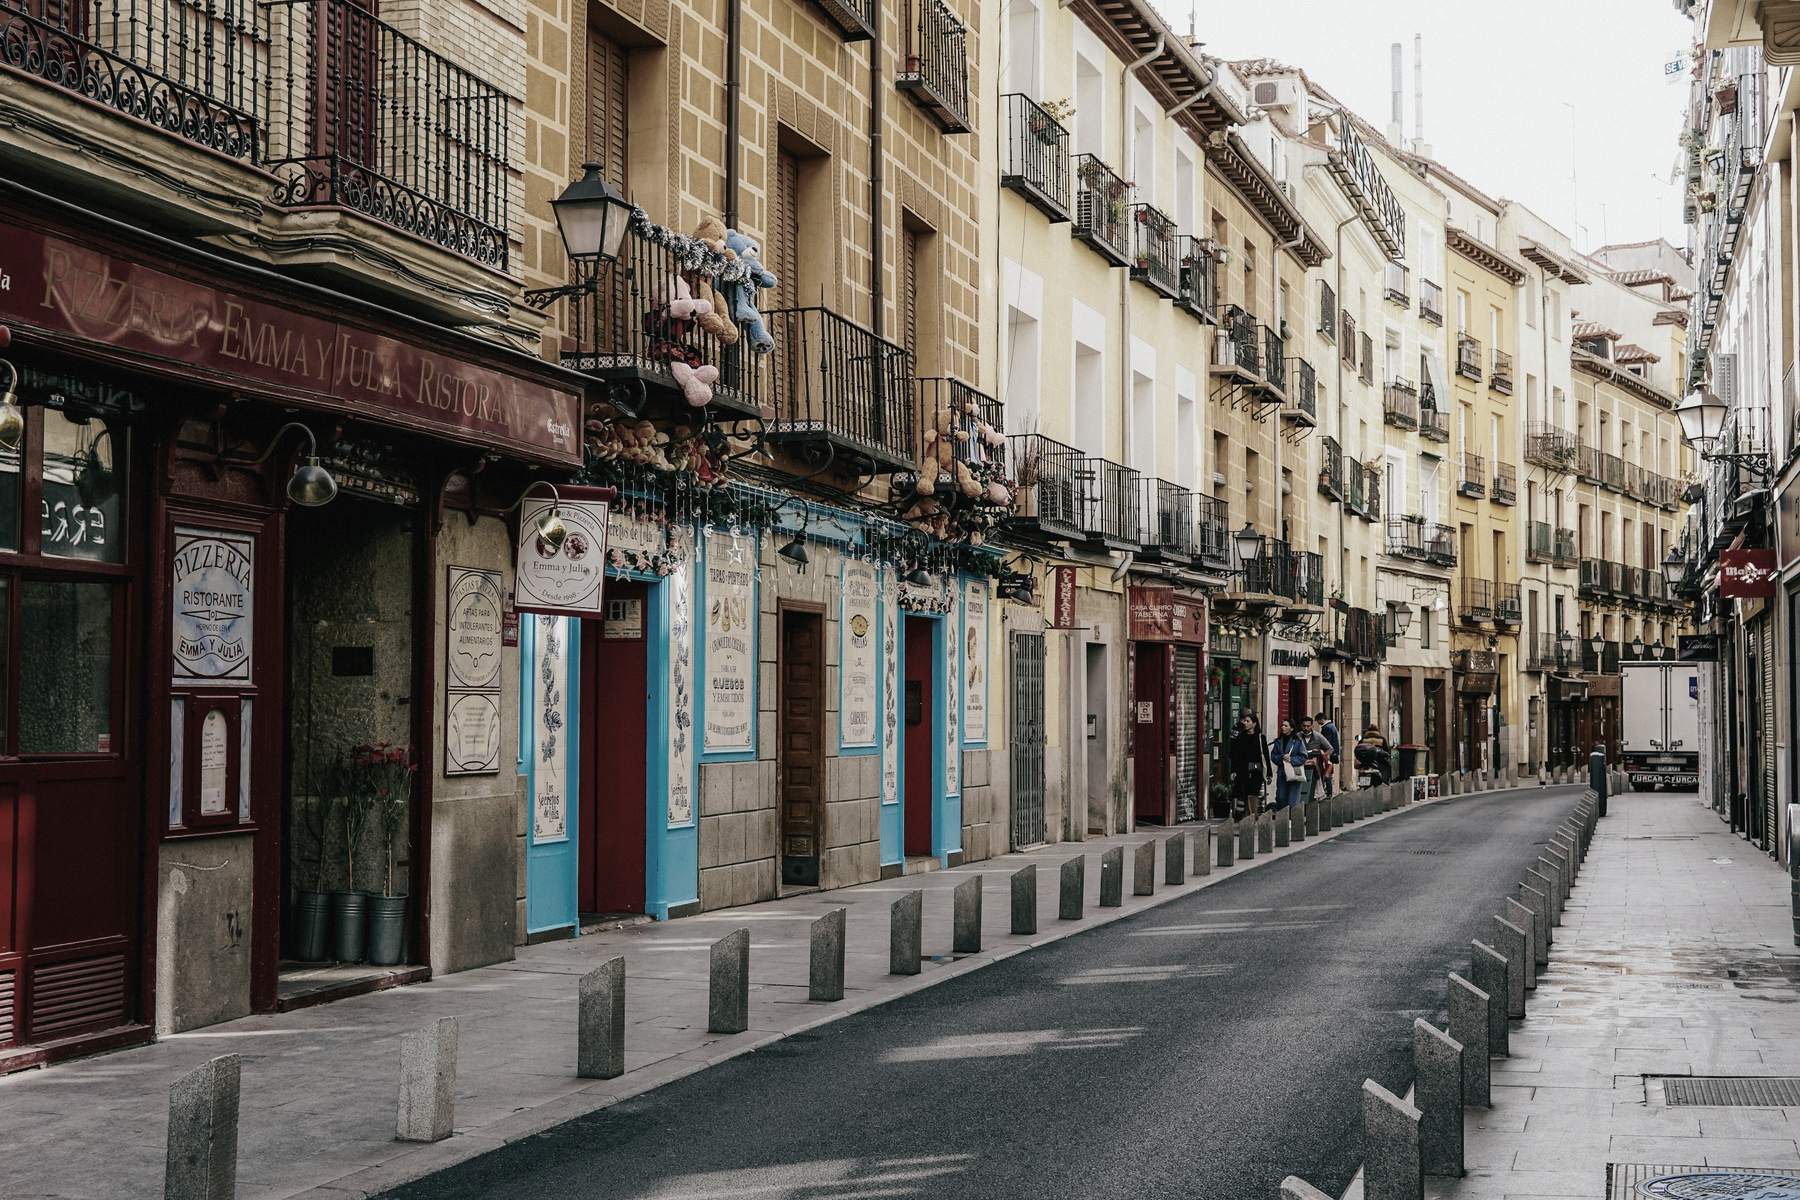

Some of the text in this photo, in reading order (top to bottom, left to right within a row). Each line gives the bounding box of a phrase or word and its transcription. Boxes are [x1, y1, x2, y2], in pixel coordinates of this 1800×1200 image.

[40, 249, 199, 348] PIZZERIA
[219, 300, 310, 377] EMMA
[316, 338, 335, 380] Y
[336, 332, 402, 398] JULIA
[174, 545, 250, 592] PIZZERIA
[533, 561, 587, 574] Emma y Julia
[184, 590, 243, 608] RISTORANTE
[541, 590, 561, 600] Desde
[460, 622, 493, 631] INTOLERANTES
[180, 639, 243, 659] EMMA Y JULIA
[713, 677, 744, 690] QUESOS
[1632, 774, 1700, 784] FURCAR FURCA
